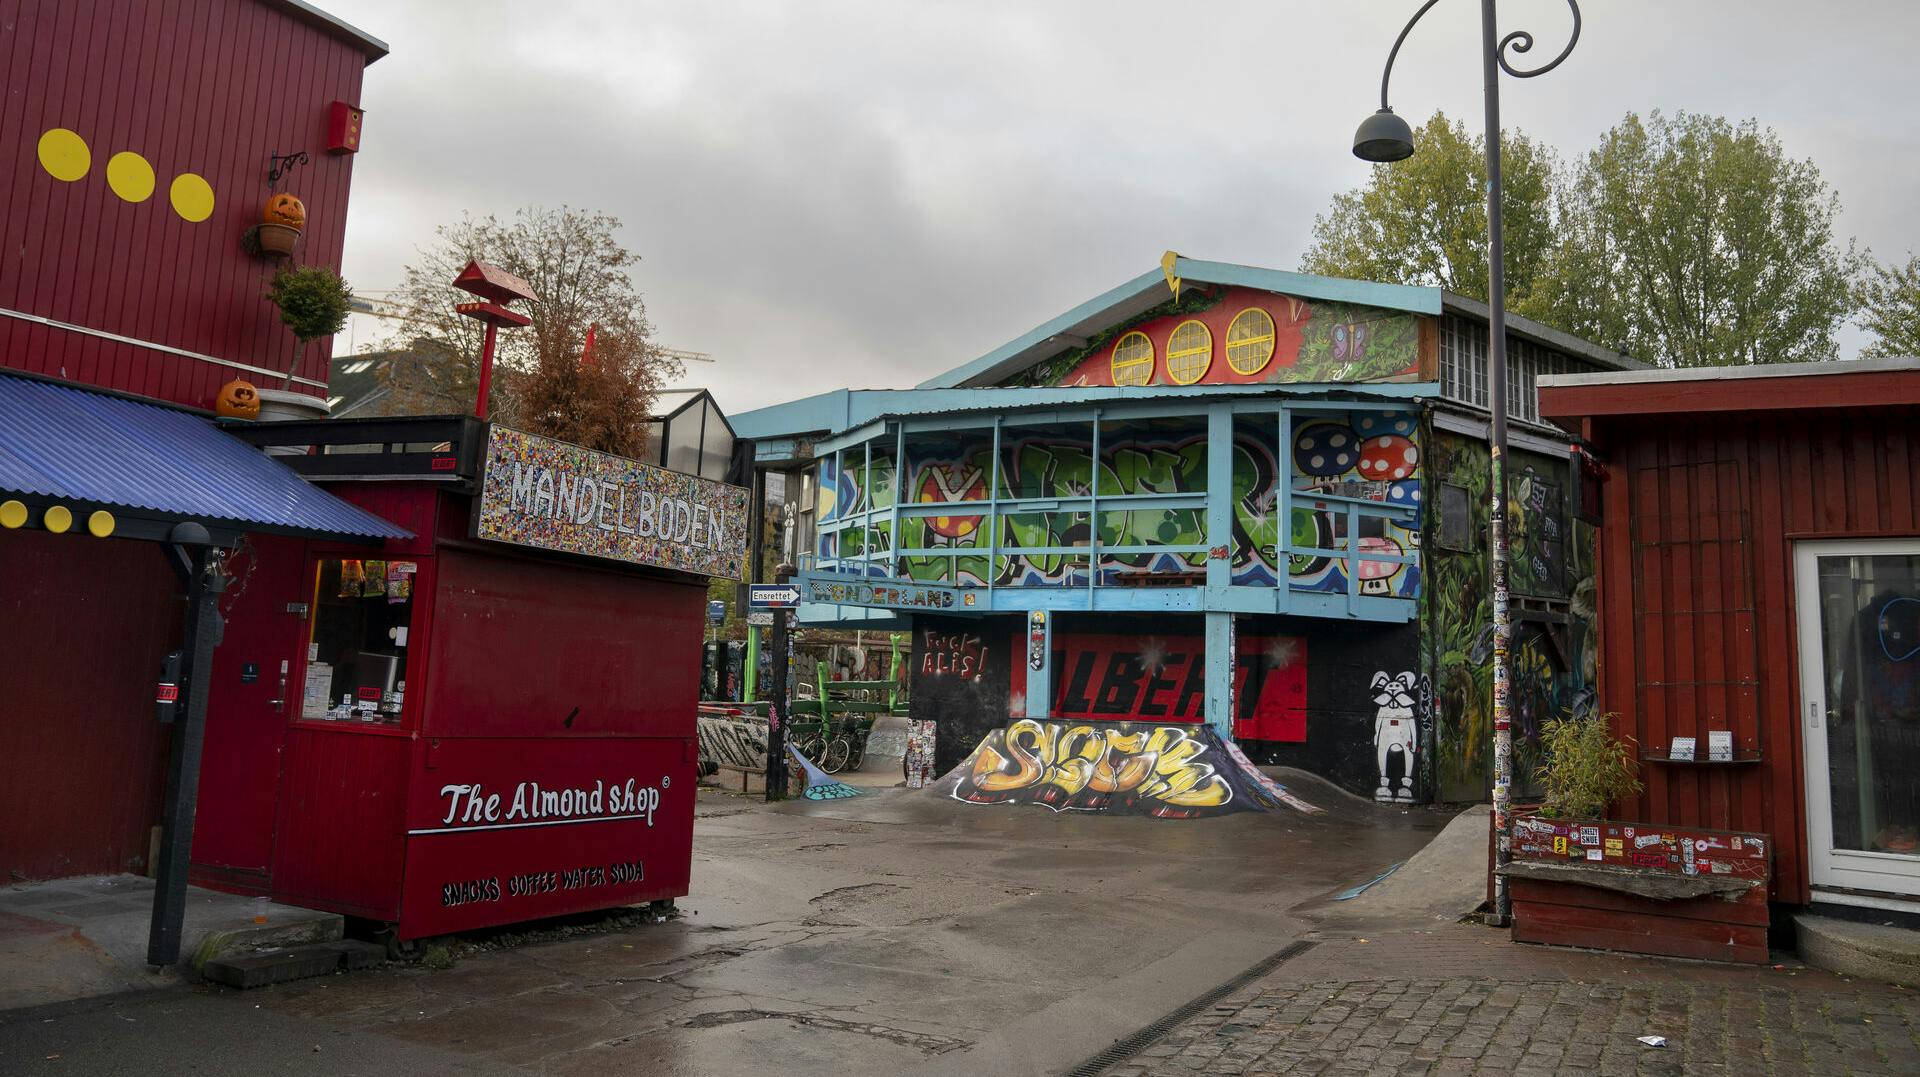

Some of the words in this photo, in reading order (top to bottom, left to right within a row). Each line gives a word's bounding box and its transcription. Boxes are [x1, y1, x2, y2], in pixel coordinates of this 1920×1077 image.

[753, 591, 790, 601] Ensrettet
[811, 583, 953, 608] WONDERLAND
[440, 784, 501, 824] The
[505, 780, 603, 820] Almond
[442, 877, 501, 907] SNACKS
[508, 871, 557, 897] COFFEE
[562, 865, 607, 890] WATER
[610, 860, 645, 884] SODA
